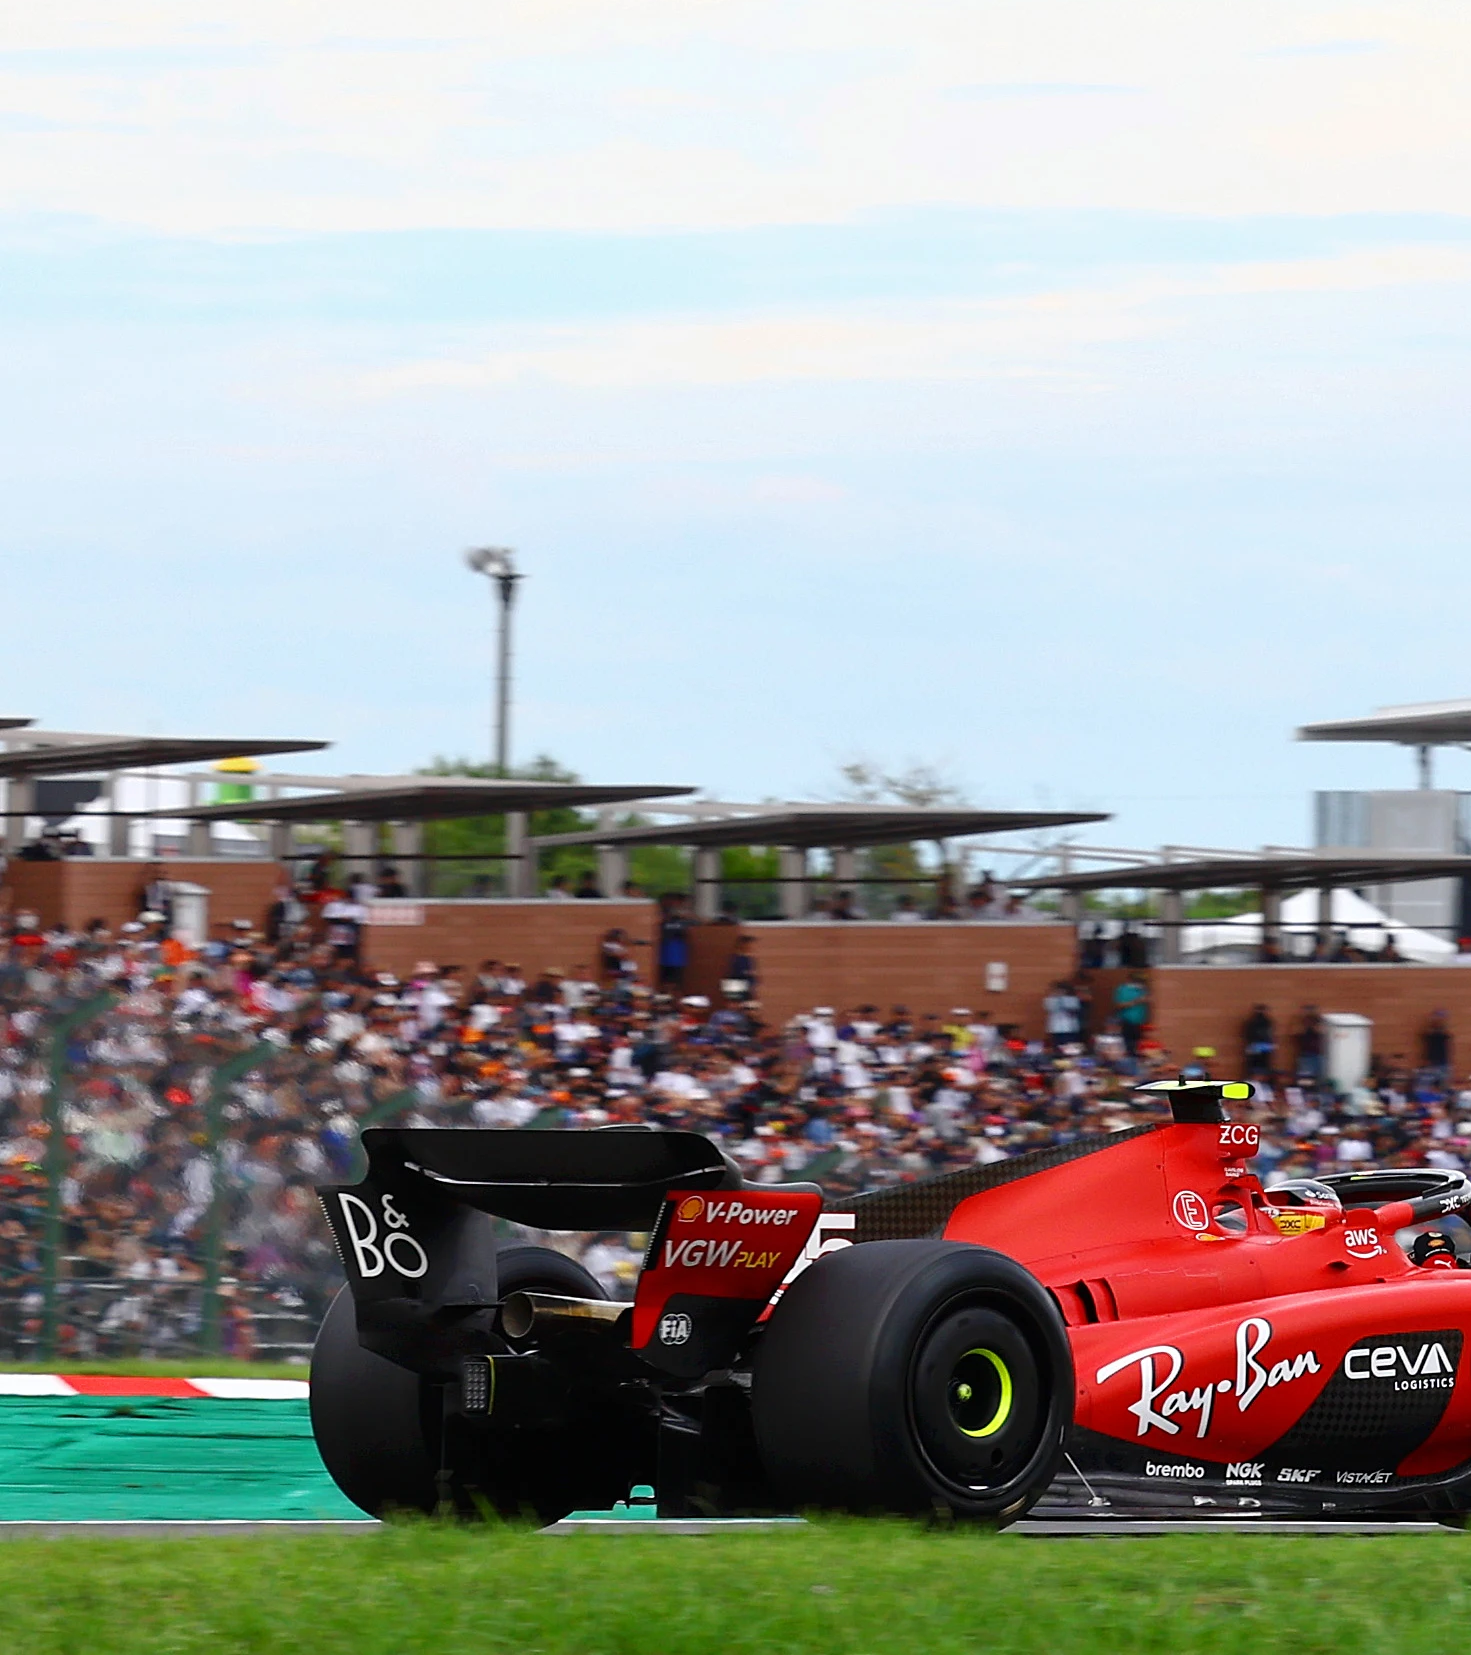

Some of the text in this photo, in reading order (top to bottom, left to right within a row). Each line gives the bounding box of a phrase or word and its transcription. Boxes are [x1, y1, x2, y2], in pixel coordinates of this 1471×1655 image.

[706, 1202, 798, 1225] V-Power
[1344, 1228, 1378, 1247] aws
[664, 1240, 781, 1268] VGW PLAY
[1394, 1377, 1455, 1392] LOGISTICS
[1145, 1461, 1205, 1478] brembo
[1225, 1462, 1265, 1478] NGK
[1276, 1468, 1321, 1483] SKF
